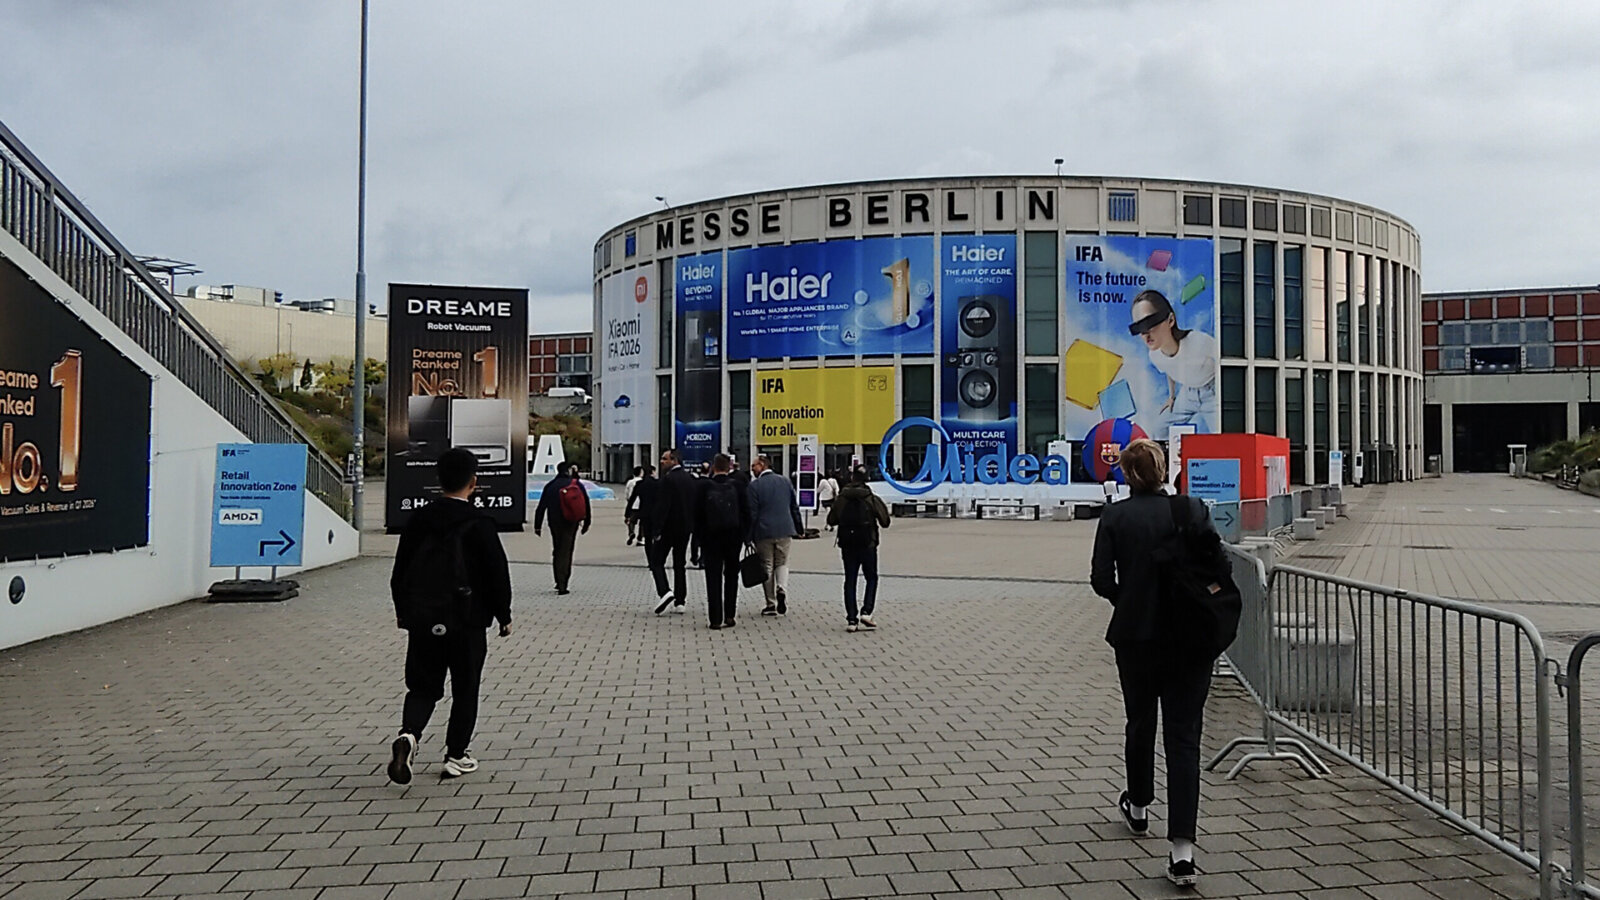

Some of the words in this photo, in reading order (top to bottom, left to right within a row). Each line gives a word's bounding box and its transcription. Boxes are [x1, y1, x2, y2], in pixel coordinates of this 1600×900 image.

[656, 204, 780, 250] MESSE
[829, 190, 1053, 227] BERLIN
[952, 244, 1005, 262] Haier
[1075, 246, 1103, 262] IFA
[682, 263, 715, 281] Haier
[1076, 271, 1102, 286] The
[1105, 272, 1147, 286] future
[685, 285, 713, 296] BEYOND
[746, 268, 832, 303] Haier
[1078, 289, 1091, 303] is
[1094, 291, 1127, 304] now.
[408, 299, 511, 317] DREAME
[826, 303, 849, 311] BRAND
[427, 322, 453, 331] Robot
[454, 323, 492, 332] Vacuums
[608, 313, 641, 340] Xiaomi
[412, 348, 463, 360] Dreame
[620, 338, 641, 357] 2026
[412, 360, 460, 370] Ranked
[473, 346, 499, 399] 1
[762, 378, 785, 394] IFA
[761, 405, 825, 420] Innovation
[51, 349, 82, 492] 1
[761, 423, 778, 437] for
[779, 422, 797, 437] all.
[953, 431, 980, 439] MULTI
[981, 431, 1006, 439] CARE
[955, 440, 1004, 448] COECTIO
[222, 449, 236, 457] IFA
[879, 416, 1069, 495] Midea
[221, 471, 250, 480] Retail
[220, 482, 272, 491] Innovation
[273, 482, 297, 491] Zone
[24, 504, 40, 514] Sales
[473, 497, 485, 508] &
[487, 496, 513, 508] 7.1B
[223, 512, 249, 521] AMD
